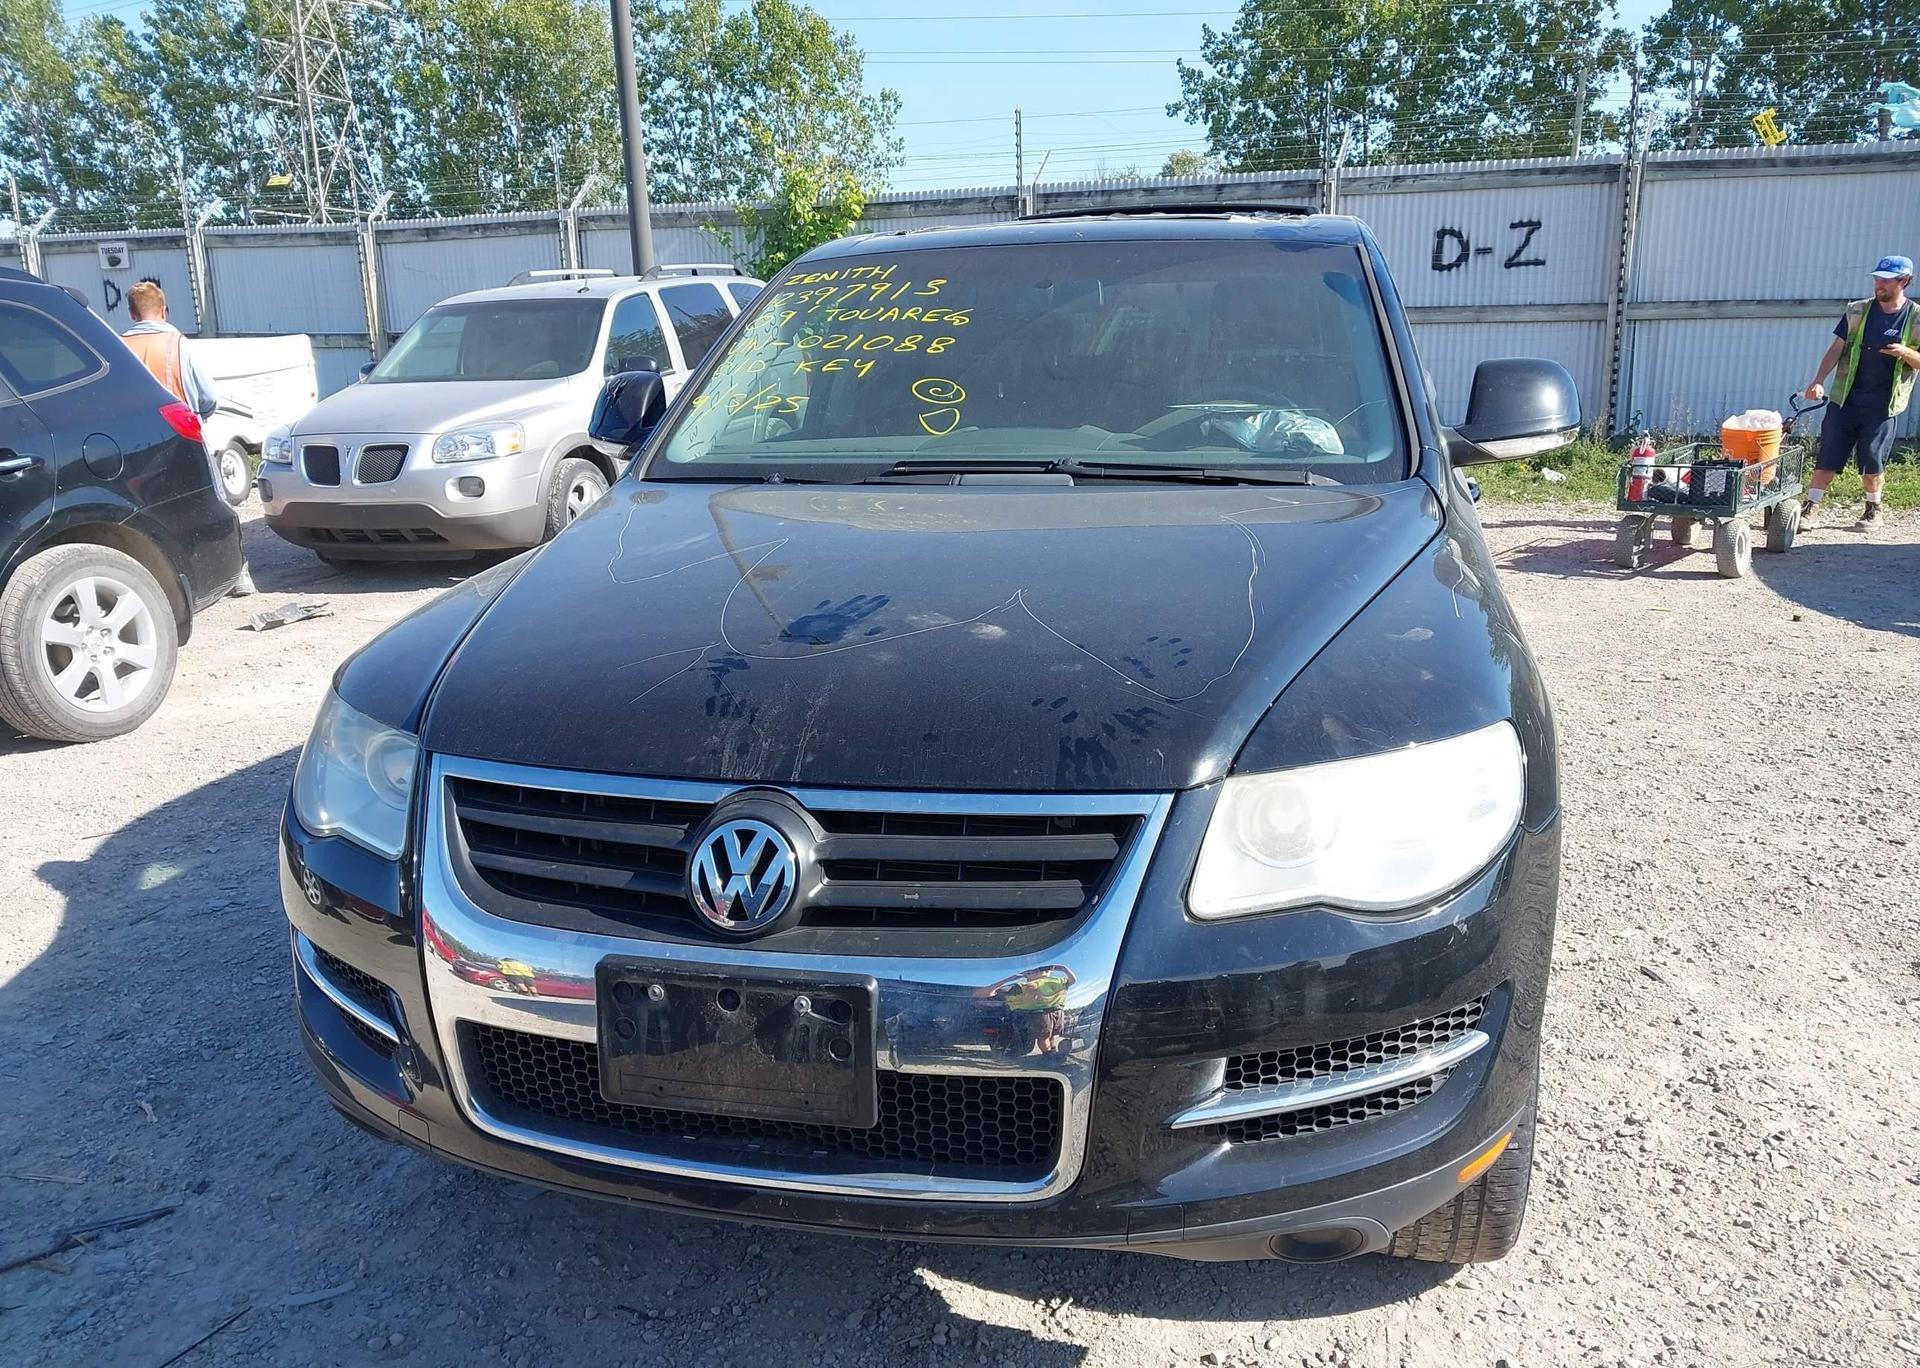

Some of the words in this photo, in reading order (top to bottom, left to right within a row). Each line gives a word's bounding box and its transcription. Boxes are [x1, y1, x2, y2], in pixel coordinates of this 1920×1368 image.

[1432, 220, 1546, 272] D-Z
[784, 264, 898, 286] ZENITH
[826, 306, 974, 326] TOUAREG
[793, 358, 877, 377] KEY
[691, 819, 796, 931] VW
